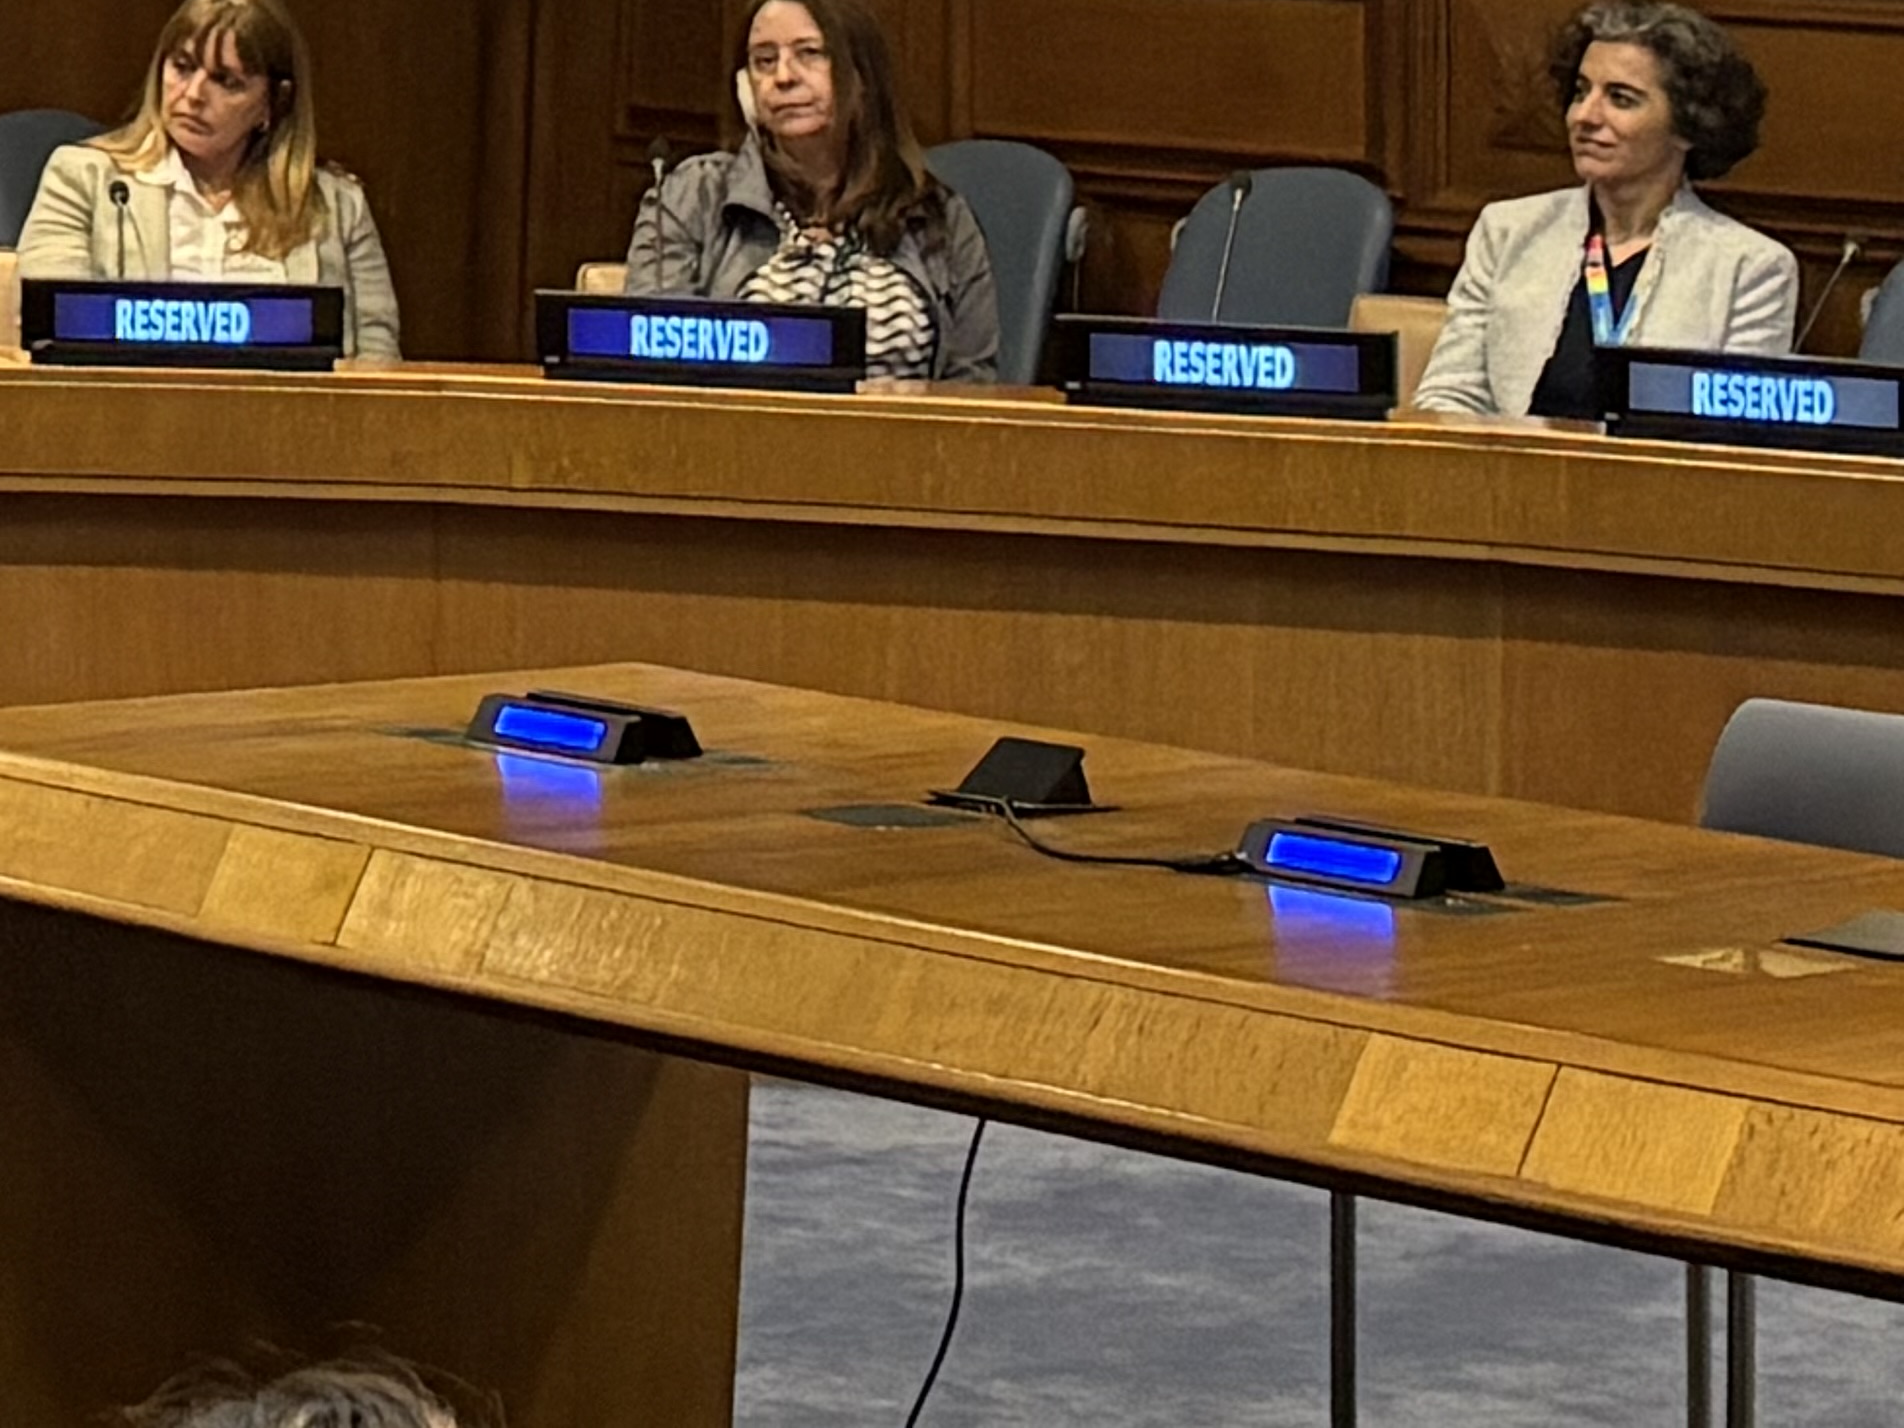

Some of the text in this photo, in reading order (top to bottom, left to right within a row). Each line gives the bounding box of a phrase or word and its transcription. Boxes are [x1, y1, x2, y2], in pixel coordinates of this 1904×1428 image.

[115, 298, 250, 342] RESERVED
[631, 314, 769, 362] RESERVED
[1153, 339, 1295, 389] RESERVED
[1693, 371, 1834, 424] RESERVED
